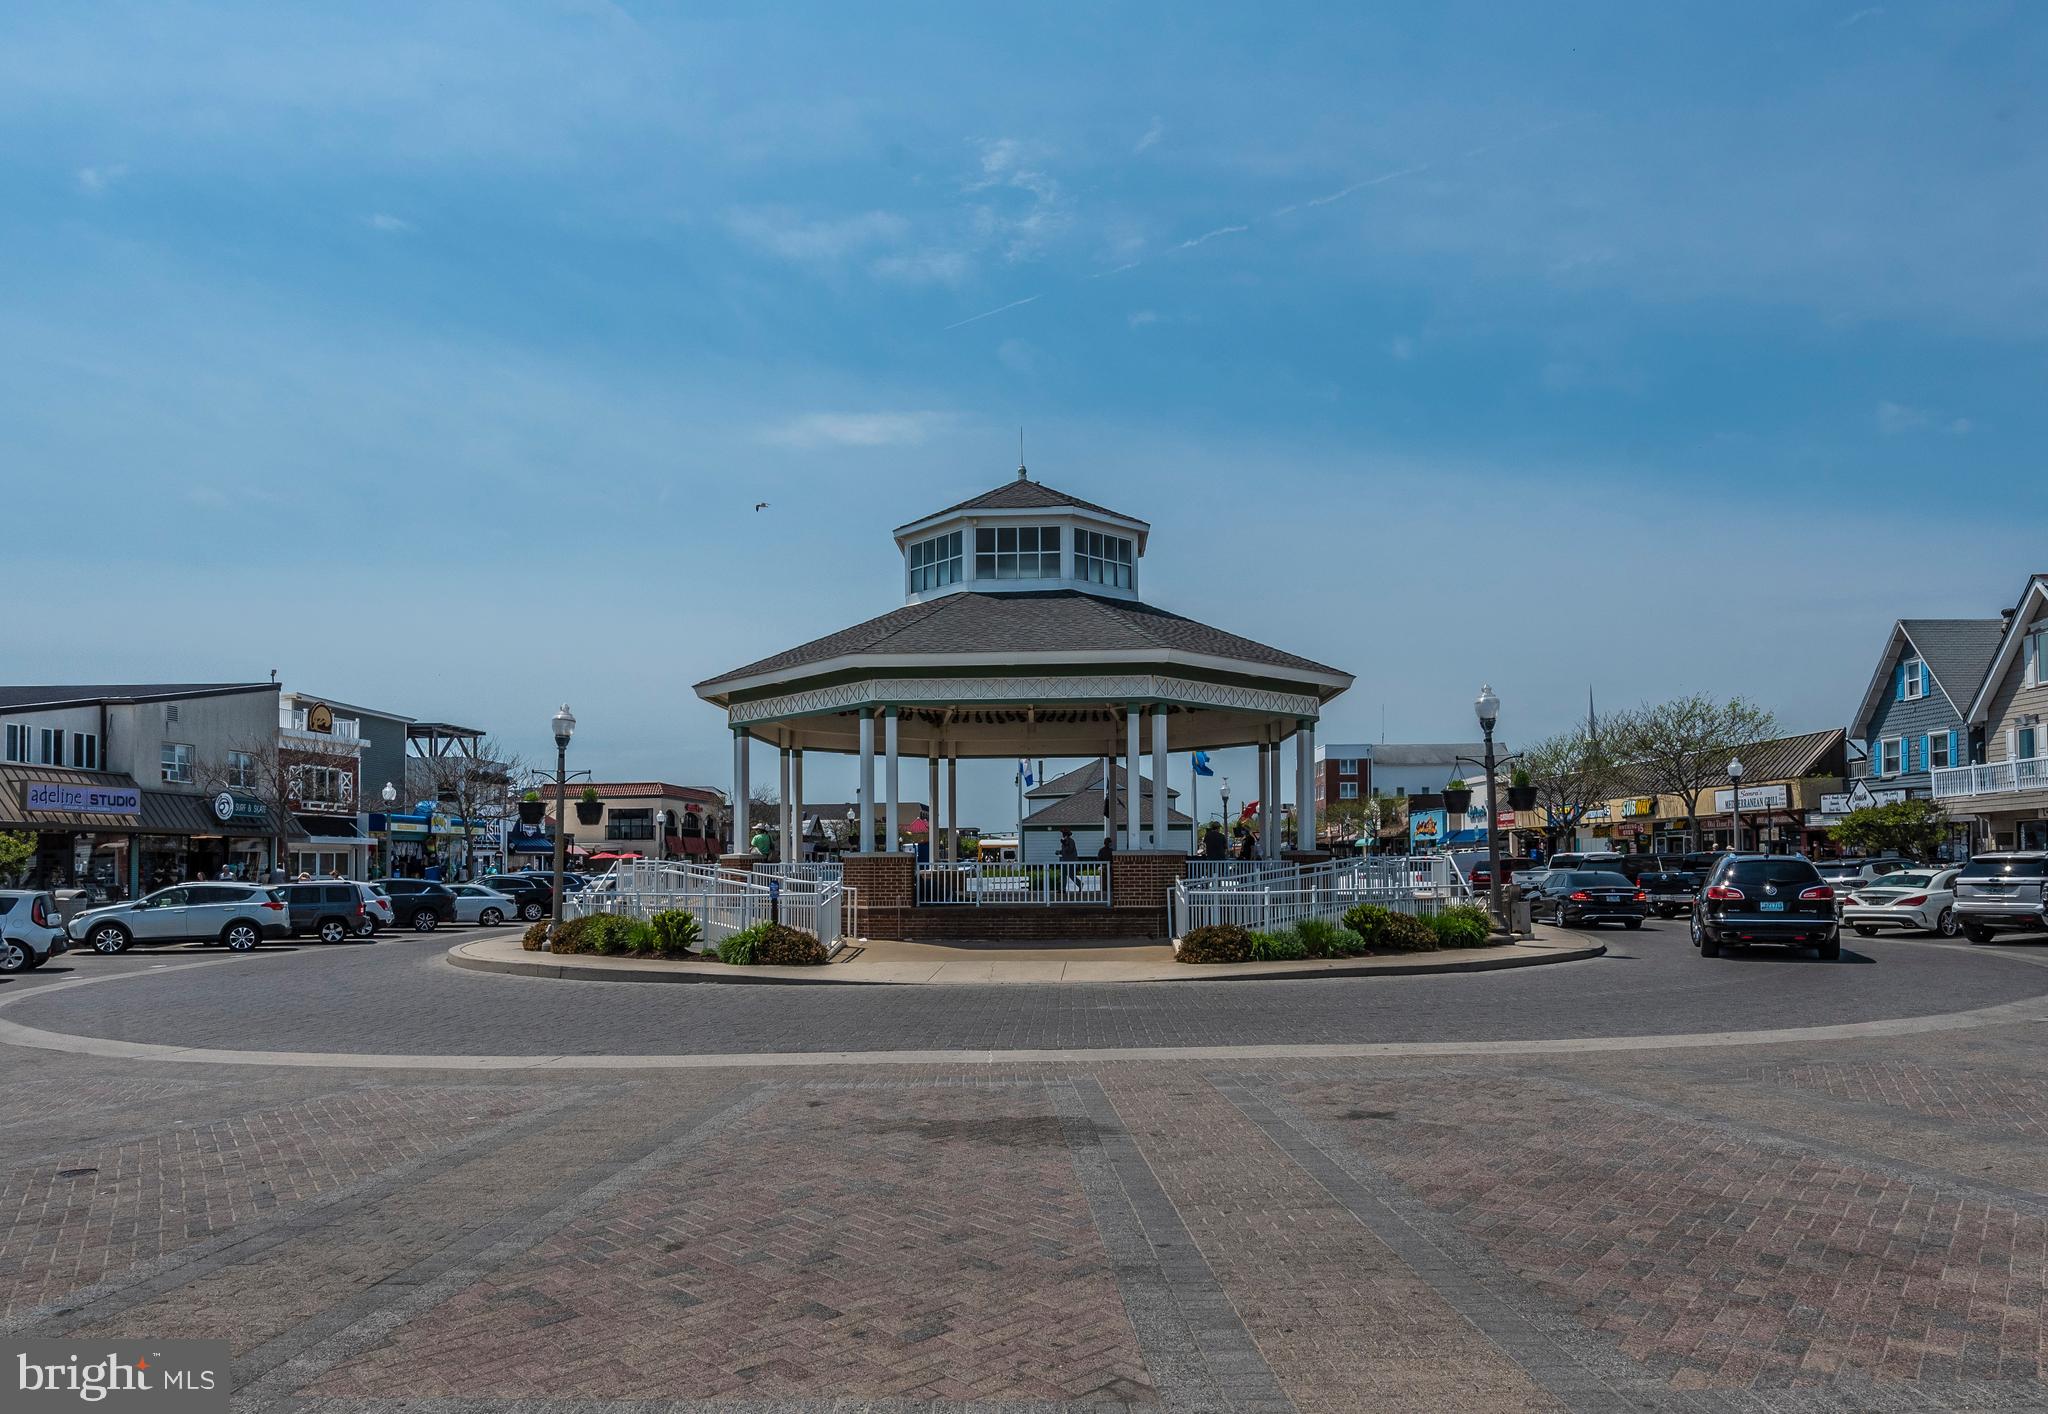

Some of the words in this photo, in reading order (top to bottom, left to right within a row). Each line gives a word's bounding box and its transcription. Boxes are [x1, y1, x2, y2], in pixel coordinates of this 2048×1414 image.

[31, 784, 82, 804] adeline
[89, 794, 137, 807] STUDIO
[1724, 797, 1763, 809] MEDERRANEAN
[1621, 799, 1653, 817] SUBWAY
